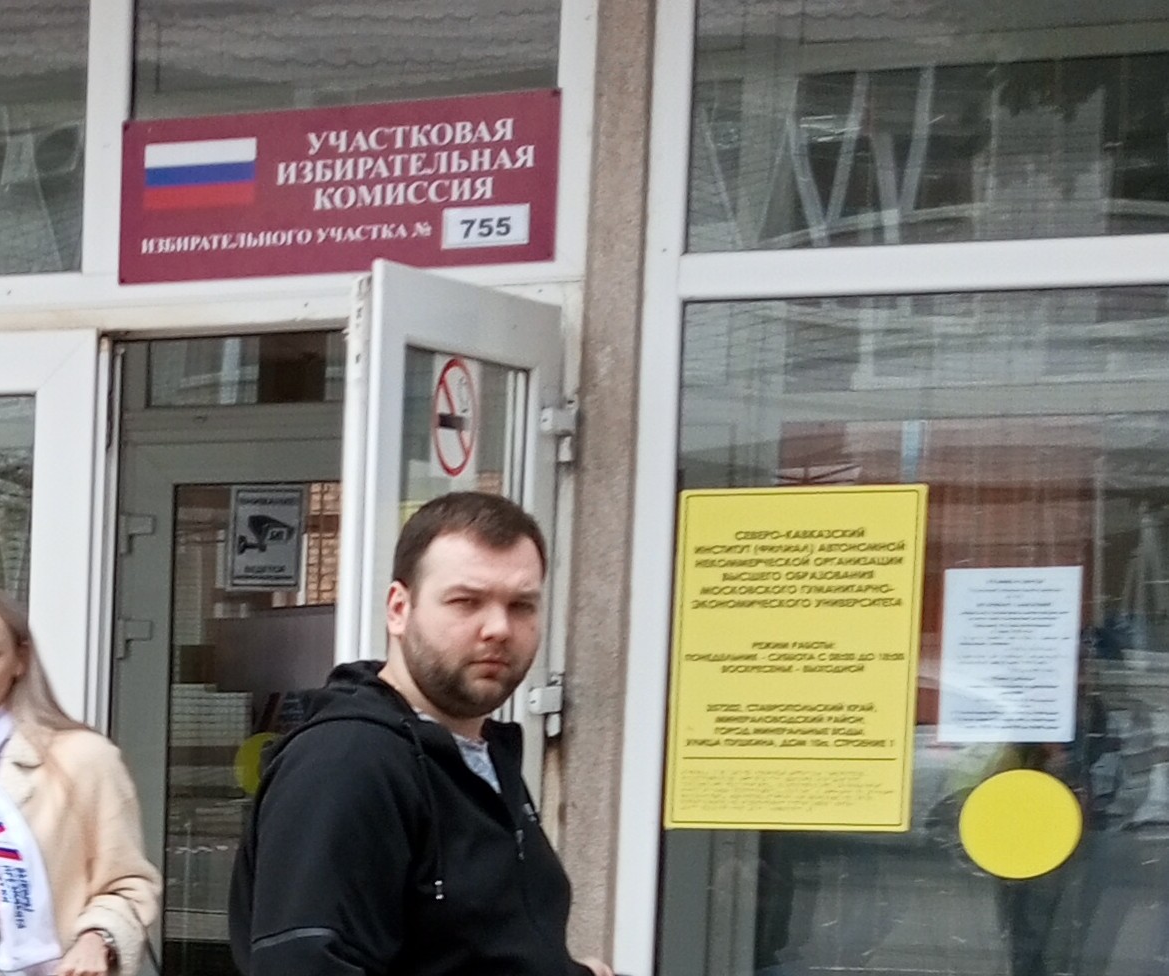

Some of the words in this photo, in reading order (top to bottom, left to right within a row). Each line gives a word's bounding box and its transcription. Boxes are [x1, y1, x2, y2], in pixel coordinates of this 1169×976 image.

[306, 118, 514, 156] УЧАСТКОВАЯ
[276, 146, 535, 186] ИЗБИРАТЕЛЬНАЯ
[313, 177, 493, 211] КОМИССИЯ
[141, 229, 312, 254] ИЗБИРАТЕЛЬНОГО
[316, 224, 407, 246] УЧАСТКА
[460, 216, 511, 239] 755
